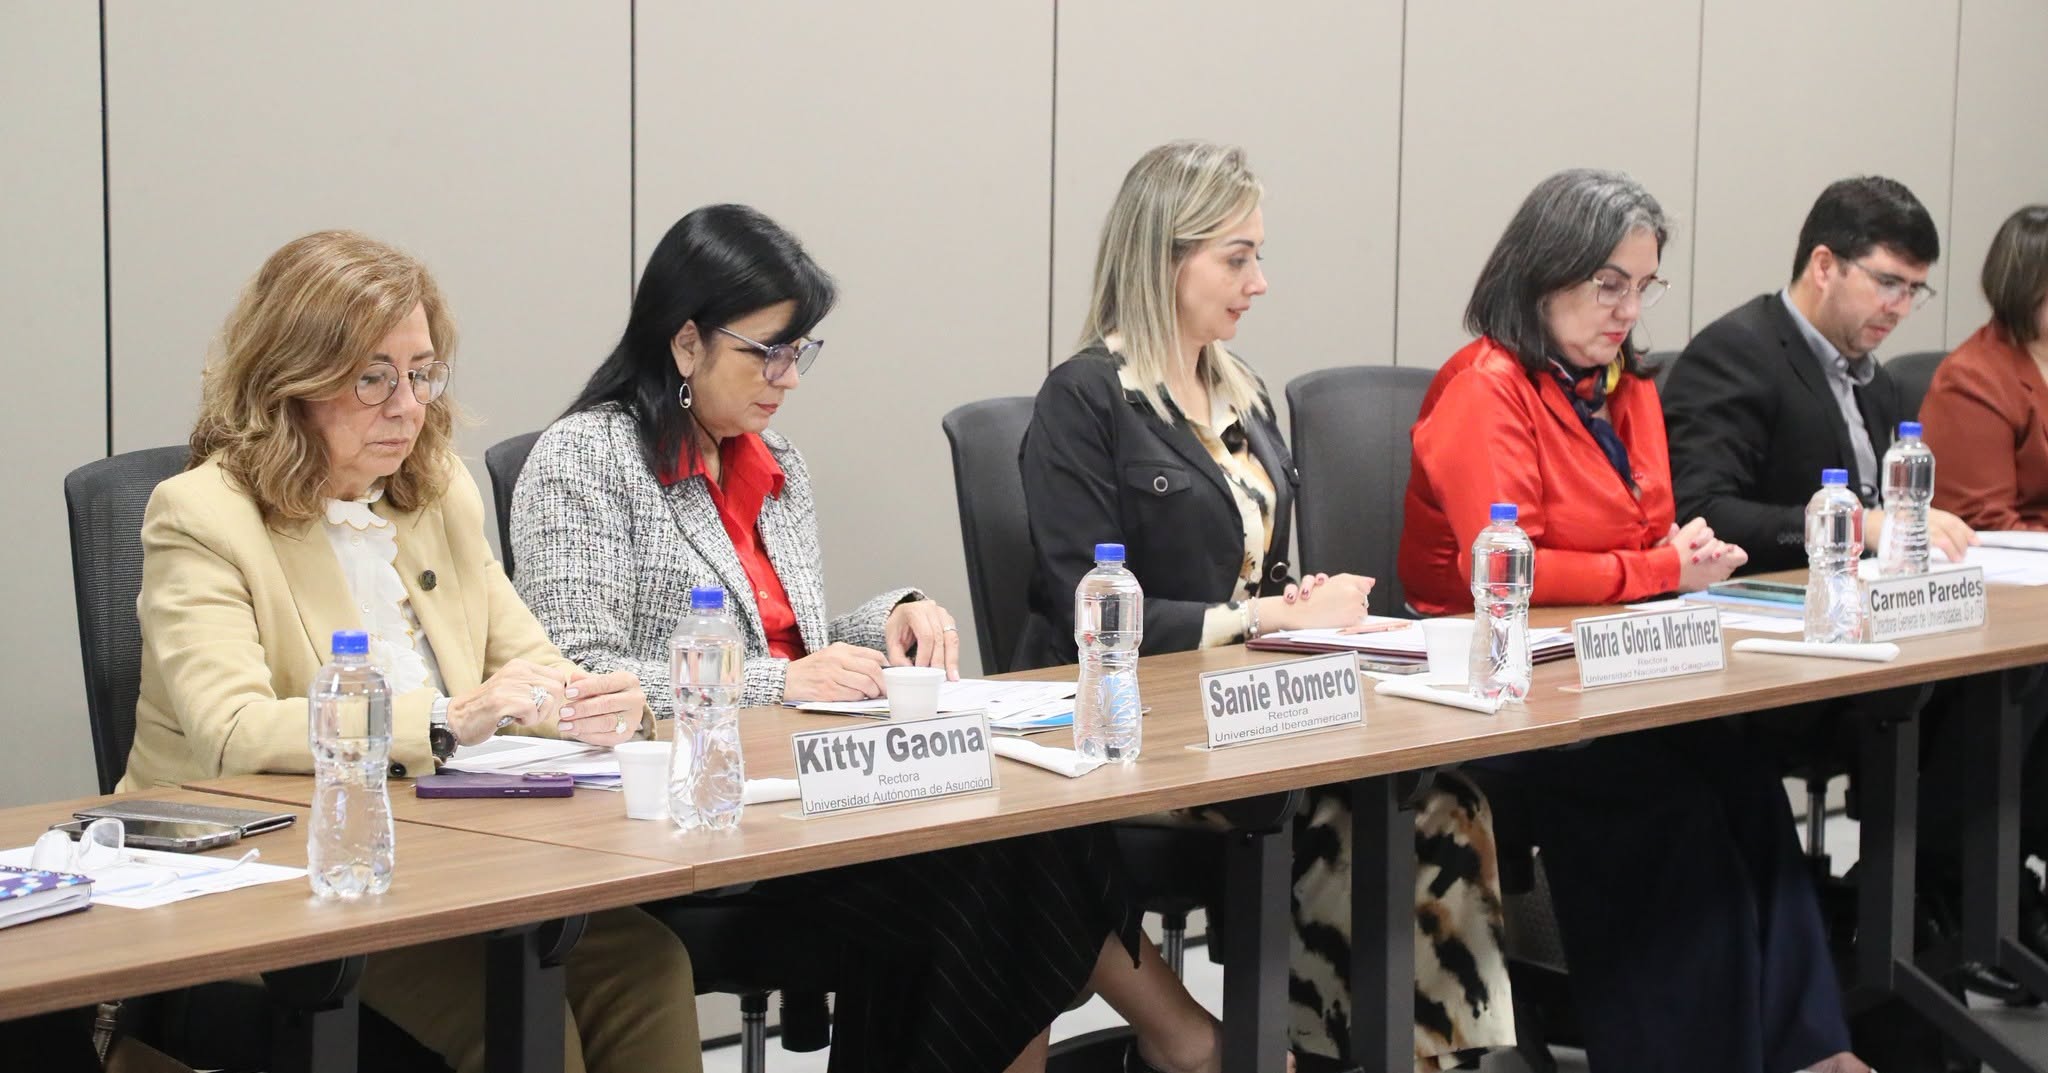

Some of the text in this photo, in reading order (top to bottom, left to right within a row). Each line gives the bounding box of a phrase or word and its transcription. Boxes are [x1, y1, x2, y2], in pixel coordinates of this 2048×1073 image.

[1871, 576, 1983, 612] Carmen Paredes
[1581, 613, 1719, 660] María Gloria Martínez
[1585, 669, 1632, 684] Universidad
[1634, 665, 1668, 678] Nacional
[1670, 663, 1680, 673] de
[1209, 668, 1356, 717] Sanie Romero
[1215, 710, 1359, 742] Universidad Iberoamericana
[1268, 707, 1309, 721] Rectora
[797, 726, 985, 776] Kitty Gaona
[806, 776, 991, 812] Universidad Autónoma de Asunción
[879, 771, 920, 786] Rectora
